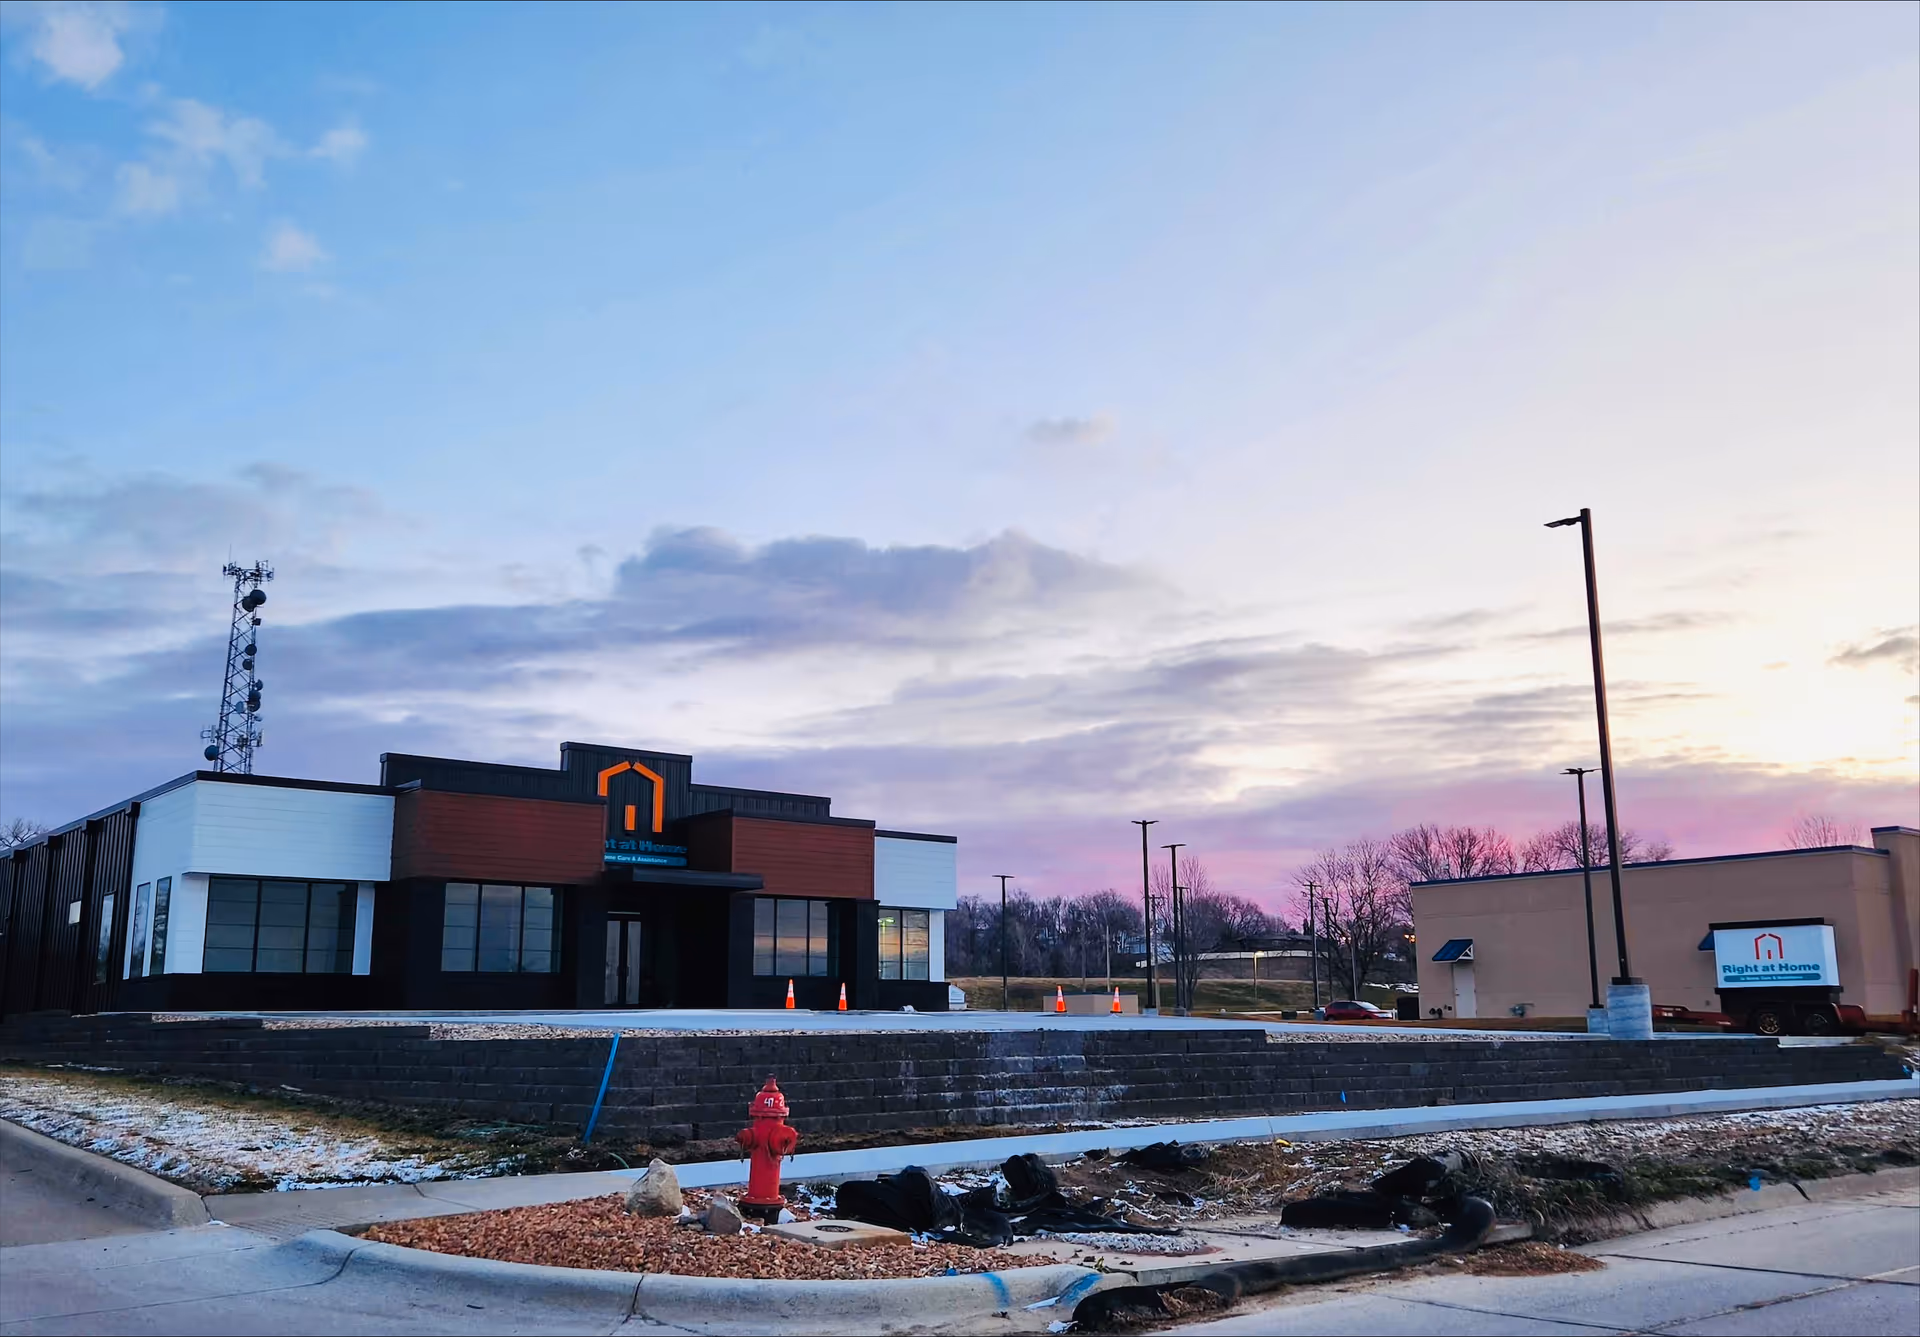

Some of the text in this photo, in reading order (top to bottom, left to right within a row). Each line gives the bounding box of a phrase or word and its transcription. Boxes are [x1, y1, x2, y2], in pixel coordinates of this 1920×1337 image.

[618, 840, 636, 850] at
[1723, 963, 1820, 974] Right at Home
